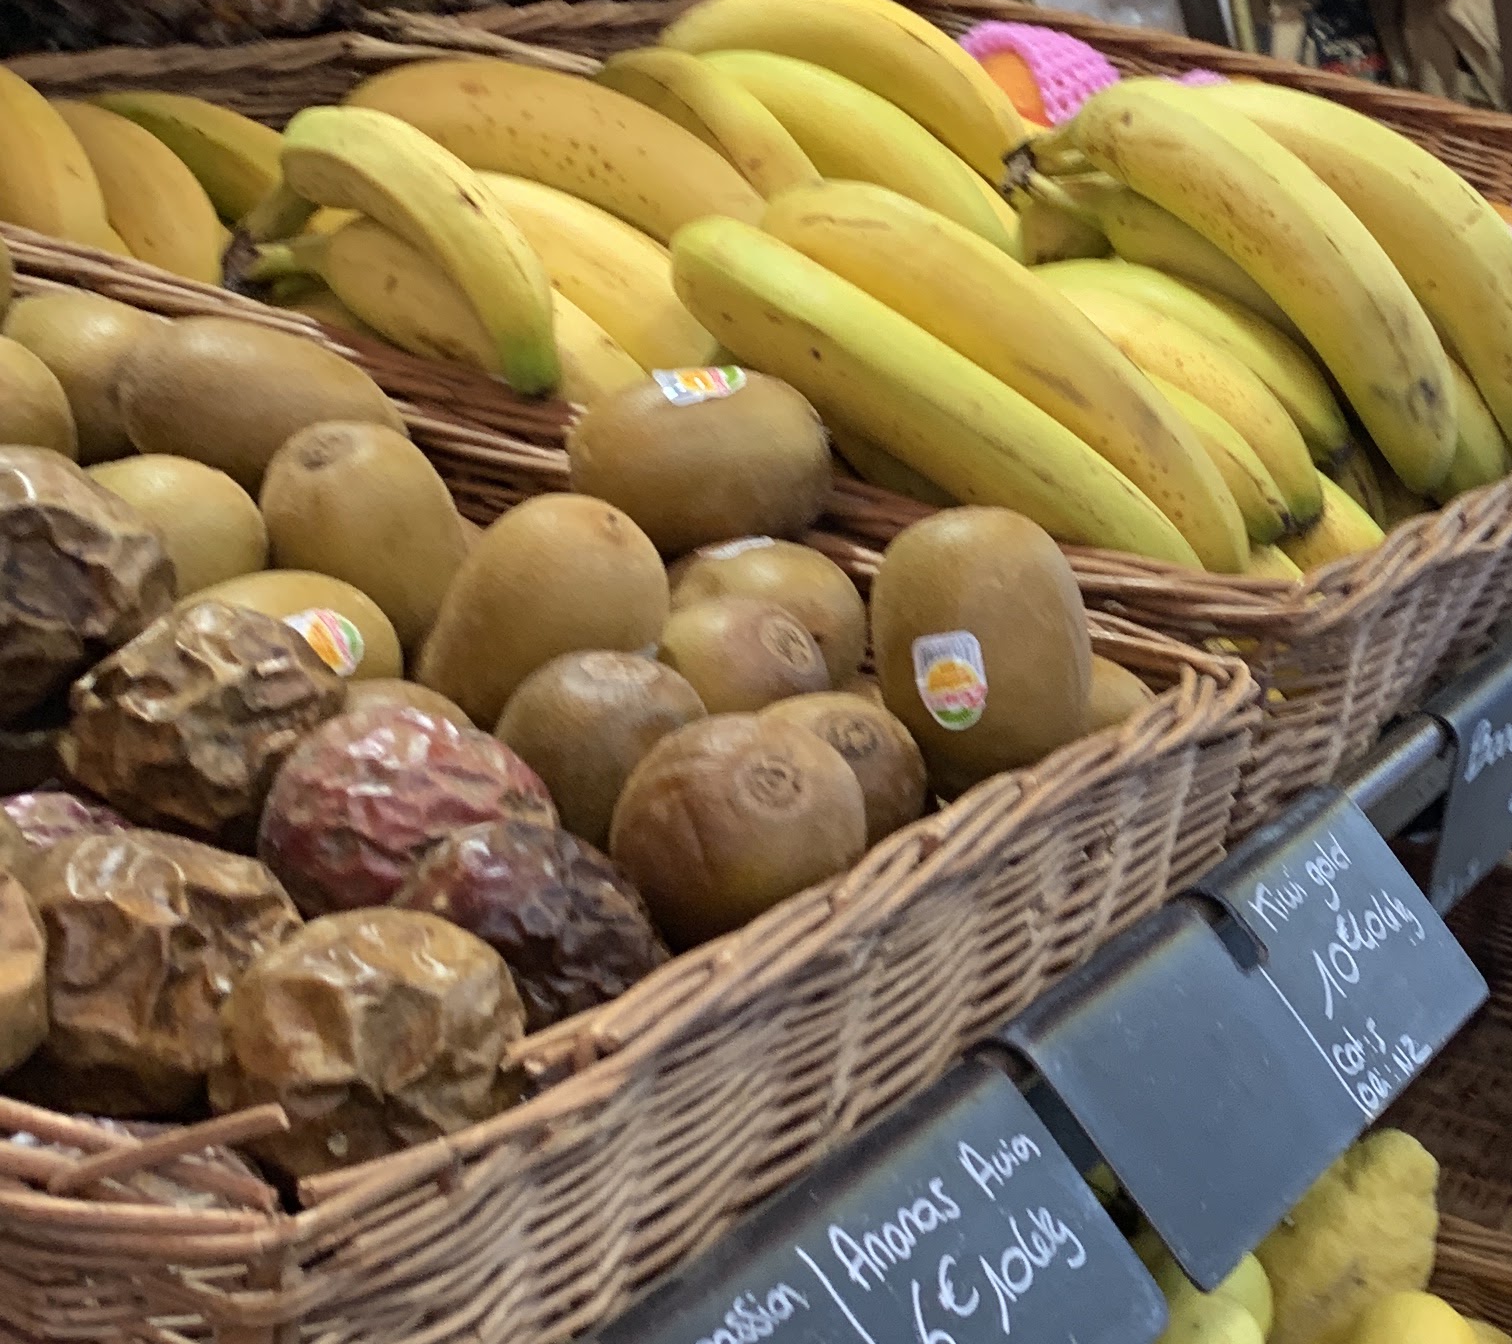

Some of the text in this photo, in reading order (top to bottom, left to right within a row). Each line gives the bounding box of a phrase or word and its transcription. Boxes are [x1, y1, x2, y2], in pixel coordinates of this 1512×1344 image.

[1248, 863, 1308, 933] Kiwi
[1304, 831, 1352, 912] gold
[828, 1177, 961, 1292] Ananas
